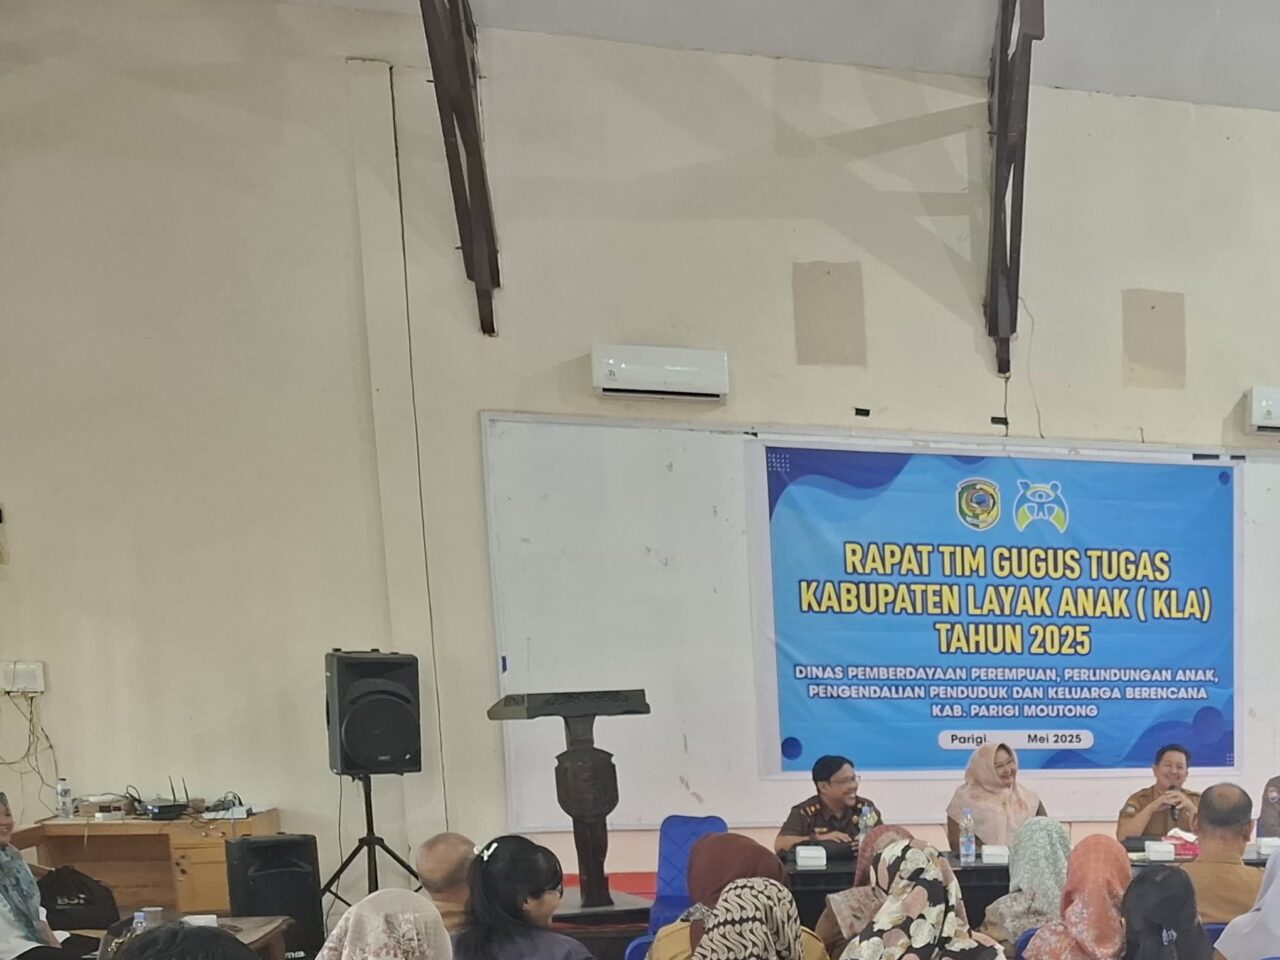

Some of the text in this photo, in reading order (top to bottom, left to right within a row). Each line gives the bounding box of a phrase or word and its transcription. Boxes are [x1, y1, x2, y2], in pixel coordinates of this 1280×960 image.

[843, 541, 1171, 582] RAPAT TIM GUGUS TUGAS
[798, 579, 961, 616] KABUPATEN
[966, 583, 1052, 617] LAYAK
[1057, 587, 1133, 619] ANAK
[934, 622, 1092, 656] TAHUN 2025
[794, 665, 1219, 683] DINAS PEMBERDAYAAN PEREMPUAN, PERLINDUNGAN ANAK,
[808, 684, 1208, 700] PENGENDALIAN PENDUDUK DAN KELUARGA BERENCANA
[931, 704, 1099, 718] KAB. PARIGI MOUTONG
[1026, 733, 1050, 744] Mei
[1053, 733, 1083, 744] 2025
